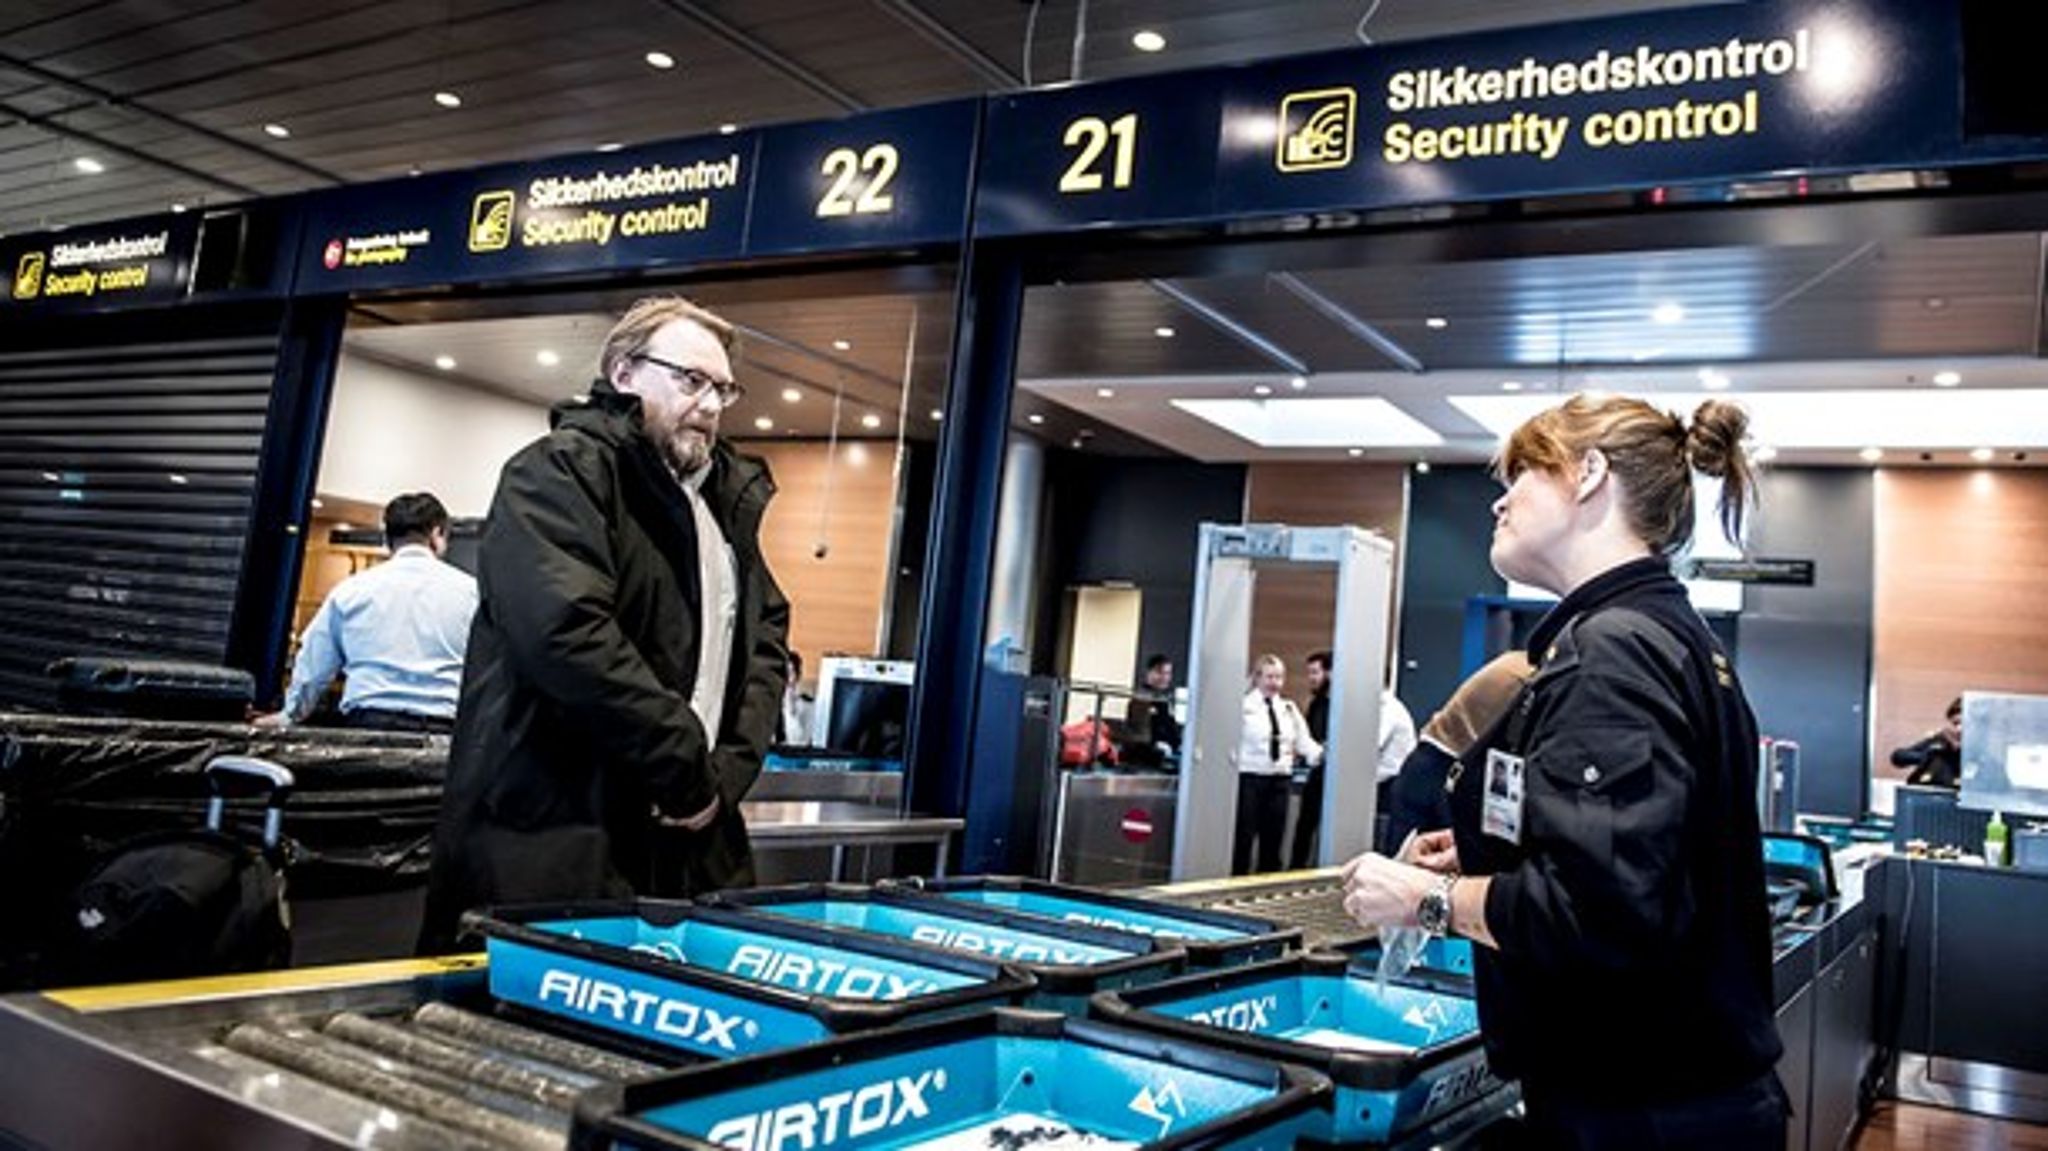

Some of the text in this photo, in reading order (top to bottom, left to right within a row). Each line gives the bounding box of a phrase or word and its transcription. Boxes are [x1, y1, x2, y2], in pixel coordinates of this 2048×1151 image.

[1386, 29, 1808, 111] Sikkerhedskontrol
[1058, 113, 1138, 192] 21
[1382, 91, 1758, 162] Security control
[527, 154, 740, 209] Sikkerhedskontrol
[816, 143, 899, 217] 22
[522, 197, 709, 245] Security control
[539, 968, 745, 1051] AIRTOX
[706, 1069, 934, 1151] AIRTOX
